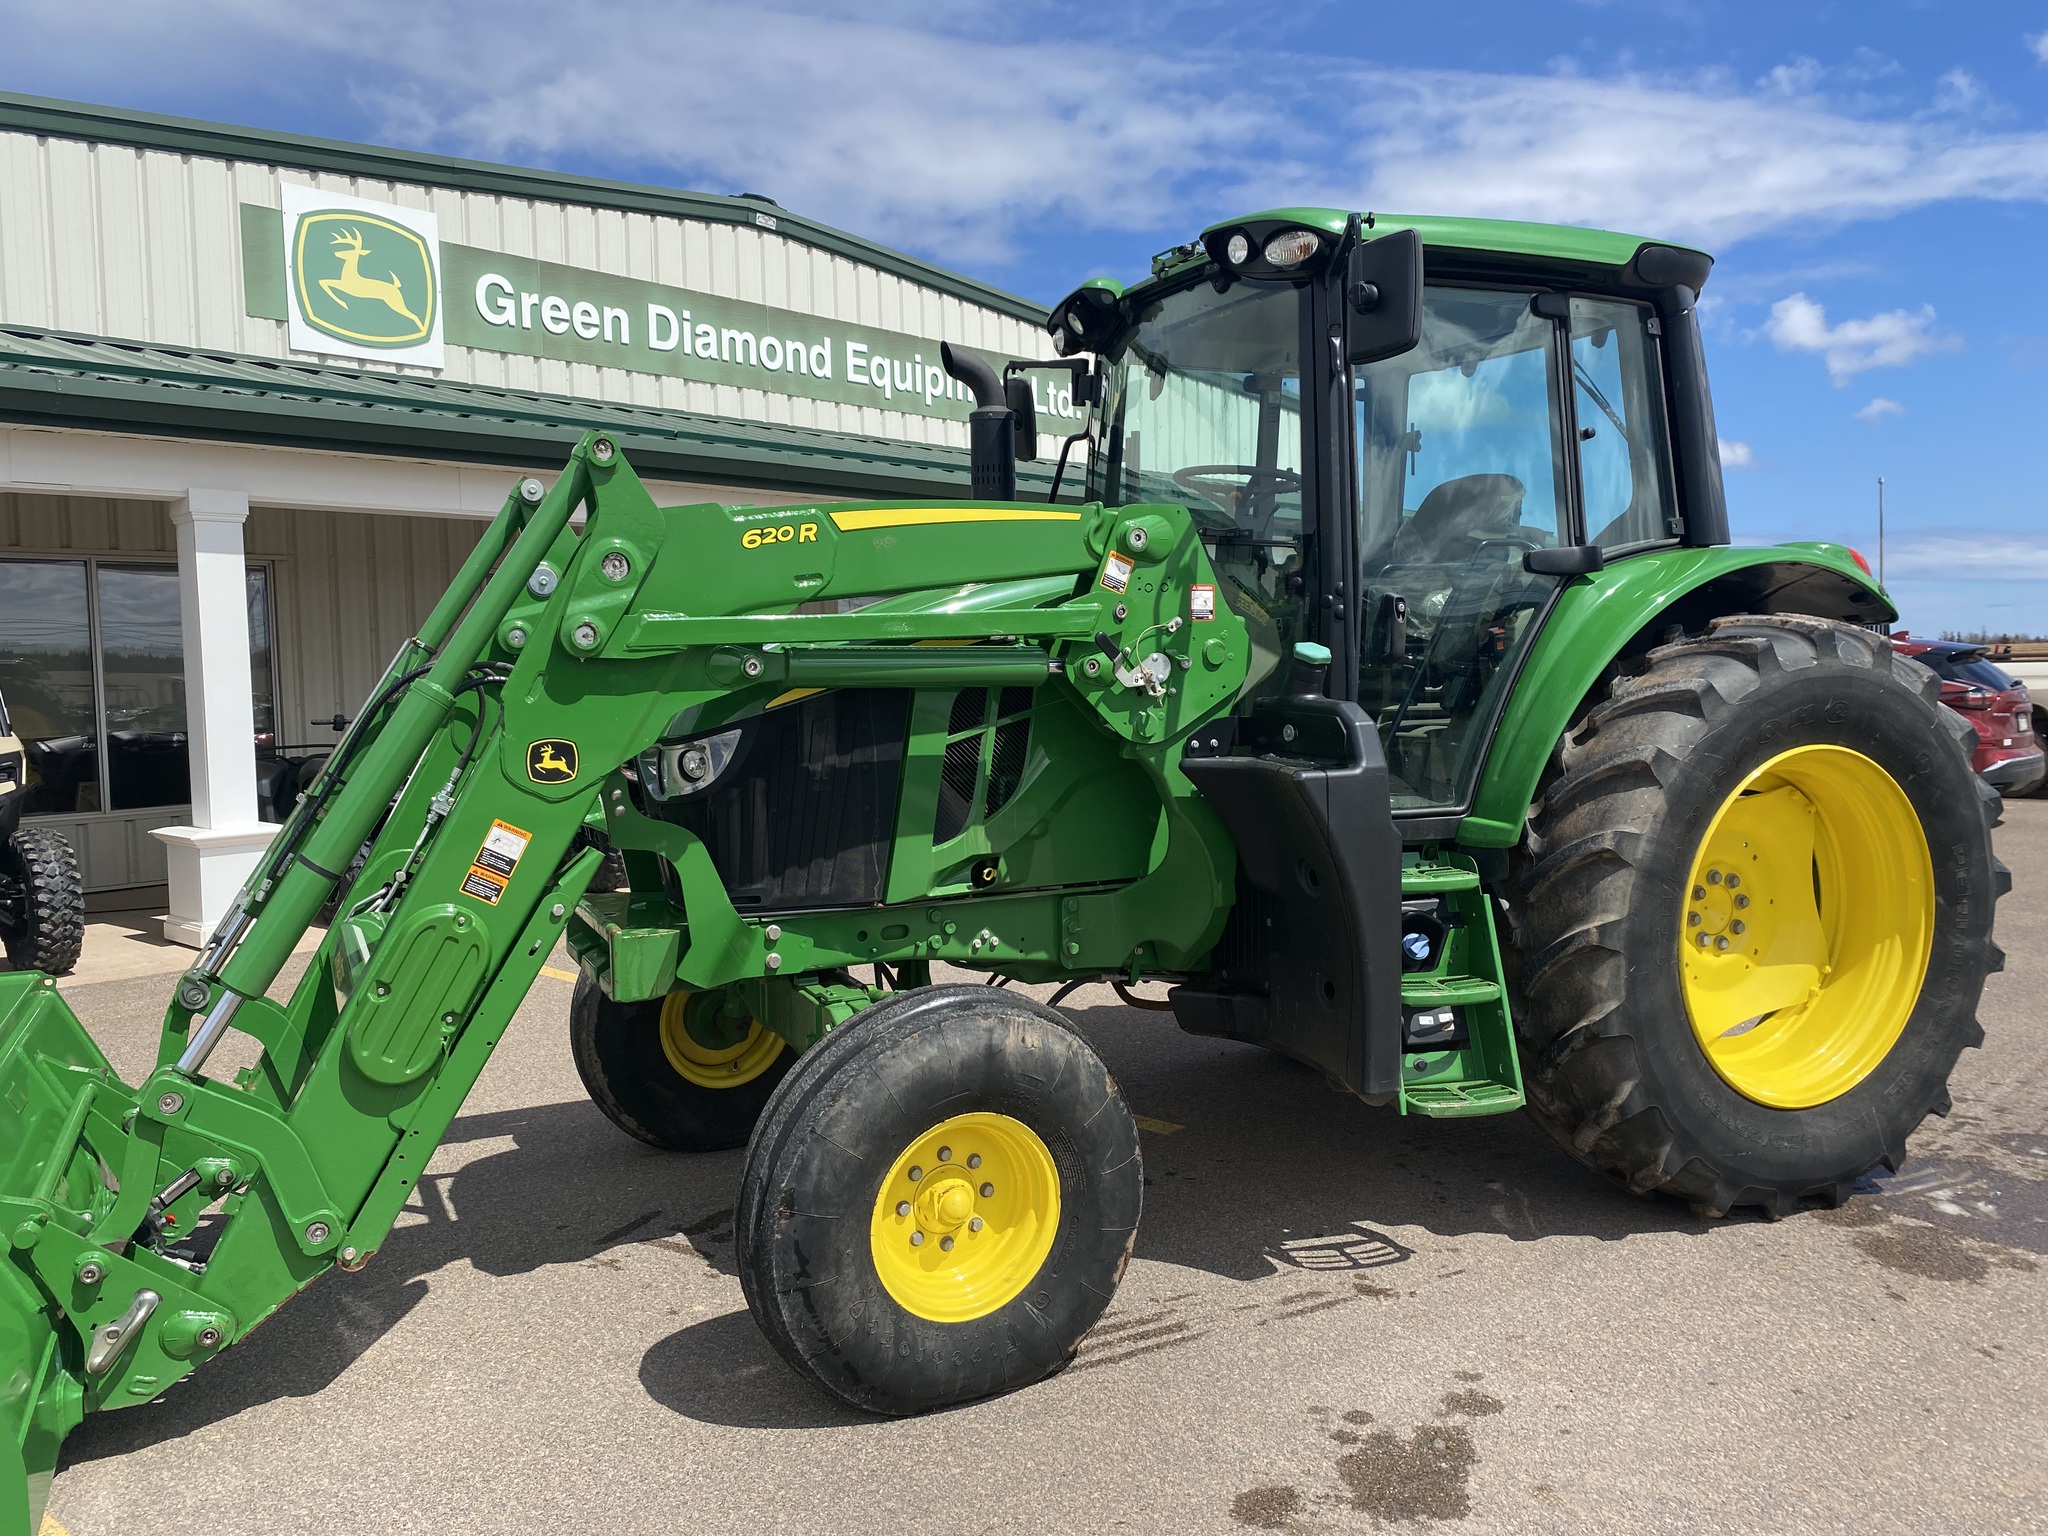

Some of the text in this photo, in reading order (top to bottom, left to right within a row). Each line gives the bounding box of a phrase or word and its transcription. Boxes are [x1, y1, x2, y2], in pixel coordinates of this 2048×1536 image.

[475, 272, 630, 346] Green
[647, 302, 833, 379] Diamond
[1030, 374, 1083, 420] Ltd.
[503, 824, 527, 838] WARNING
[480, 870, 504, 885] WARNING
